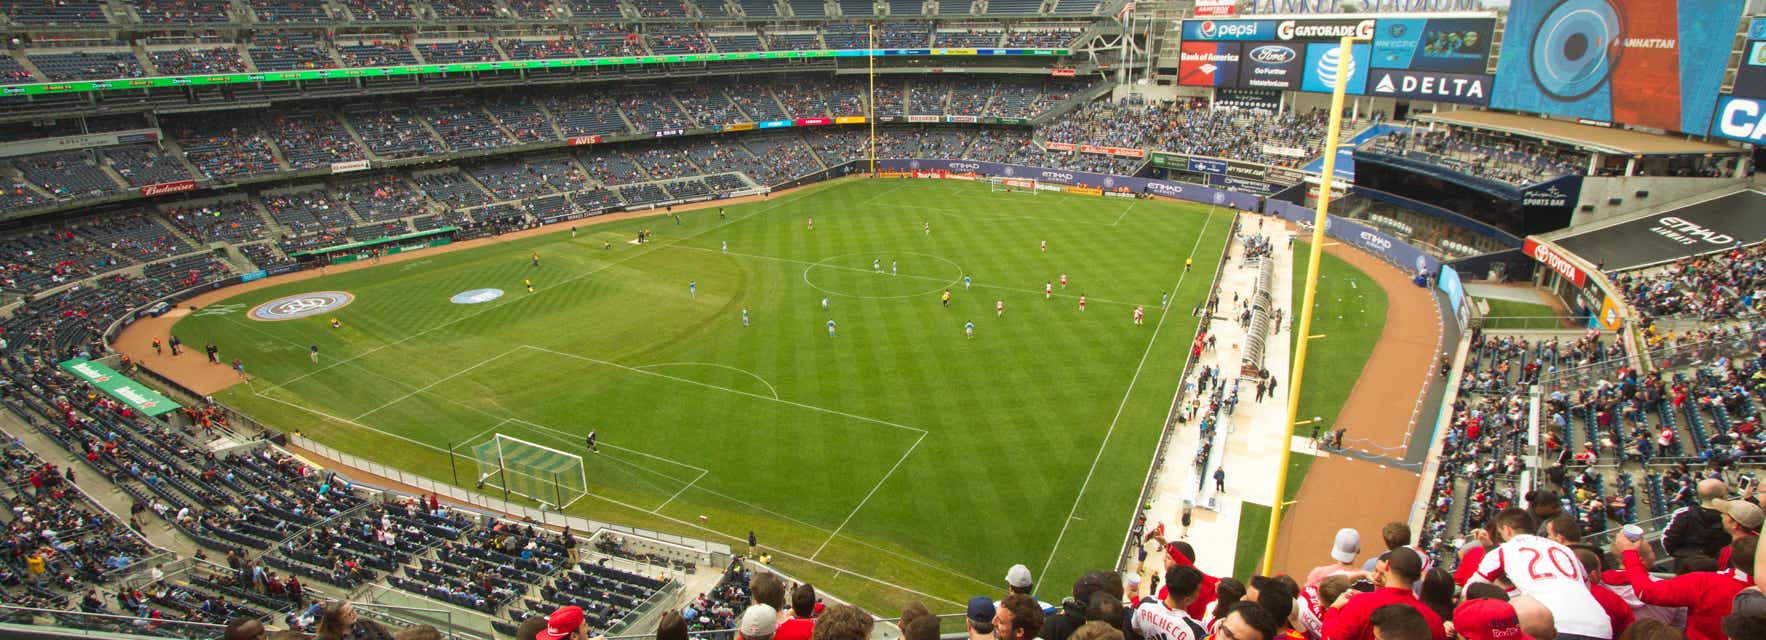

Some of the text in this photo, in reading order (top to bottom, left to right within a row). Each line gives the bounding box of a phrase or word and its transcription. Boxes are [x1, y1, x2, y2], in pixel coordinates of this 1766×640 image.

[1218, 22, 1257, 37] pepsi
[1295, 26, 1356, 36] GATORADE
[1181, 53, 1239, 61] Bank of America
[1257, 47, 1287, 61] Ford
[1254, 67, 1265, 75] Go
[1402, 76, 1483, 98] DELTA
[575, 137, 596, 145] AVIS
[145, 182, 194, 196] Budweiser
[1147, 182, 1183, 193] ETIHAD
[1649, 226, 1697, 245] AIRWAYS
[1658, 216, 1735, 245] ETIHAD
[1360, 231, 1391, 248] ETIHAD
[1547, 251, 1575, 281] TOYOTA
[1518, 546, 1578, 580] 20
[1141, 608, 1187, 640] PACHECO
